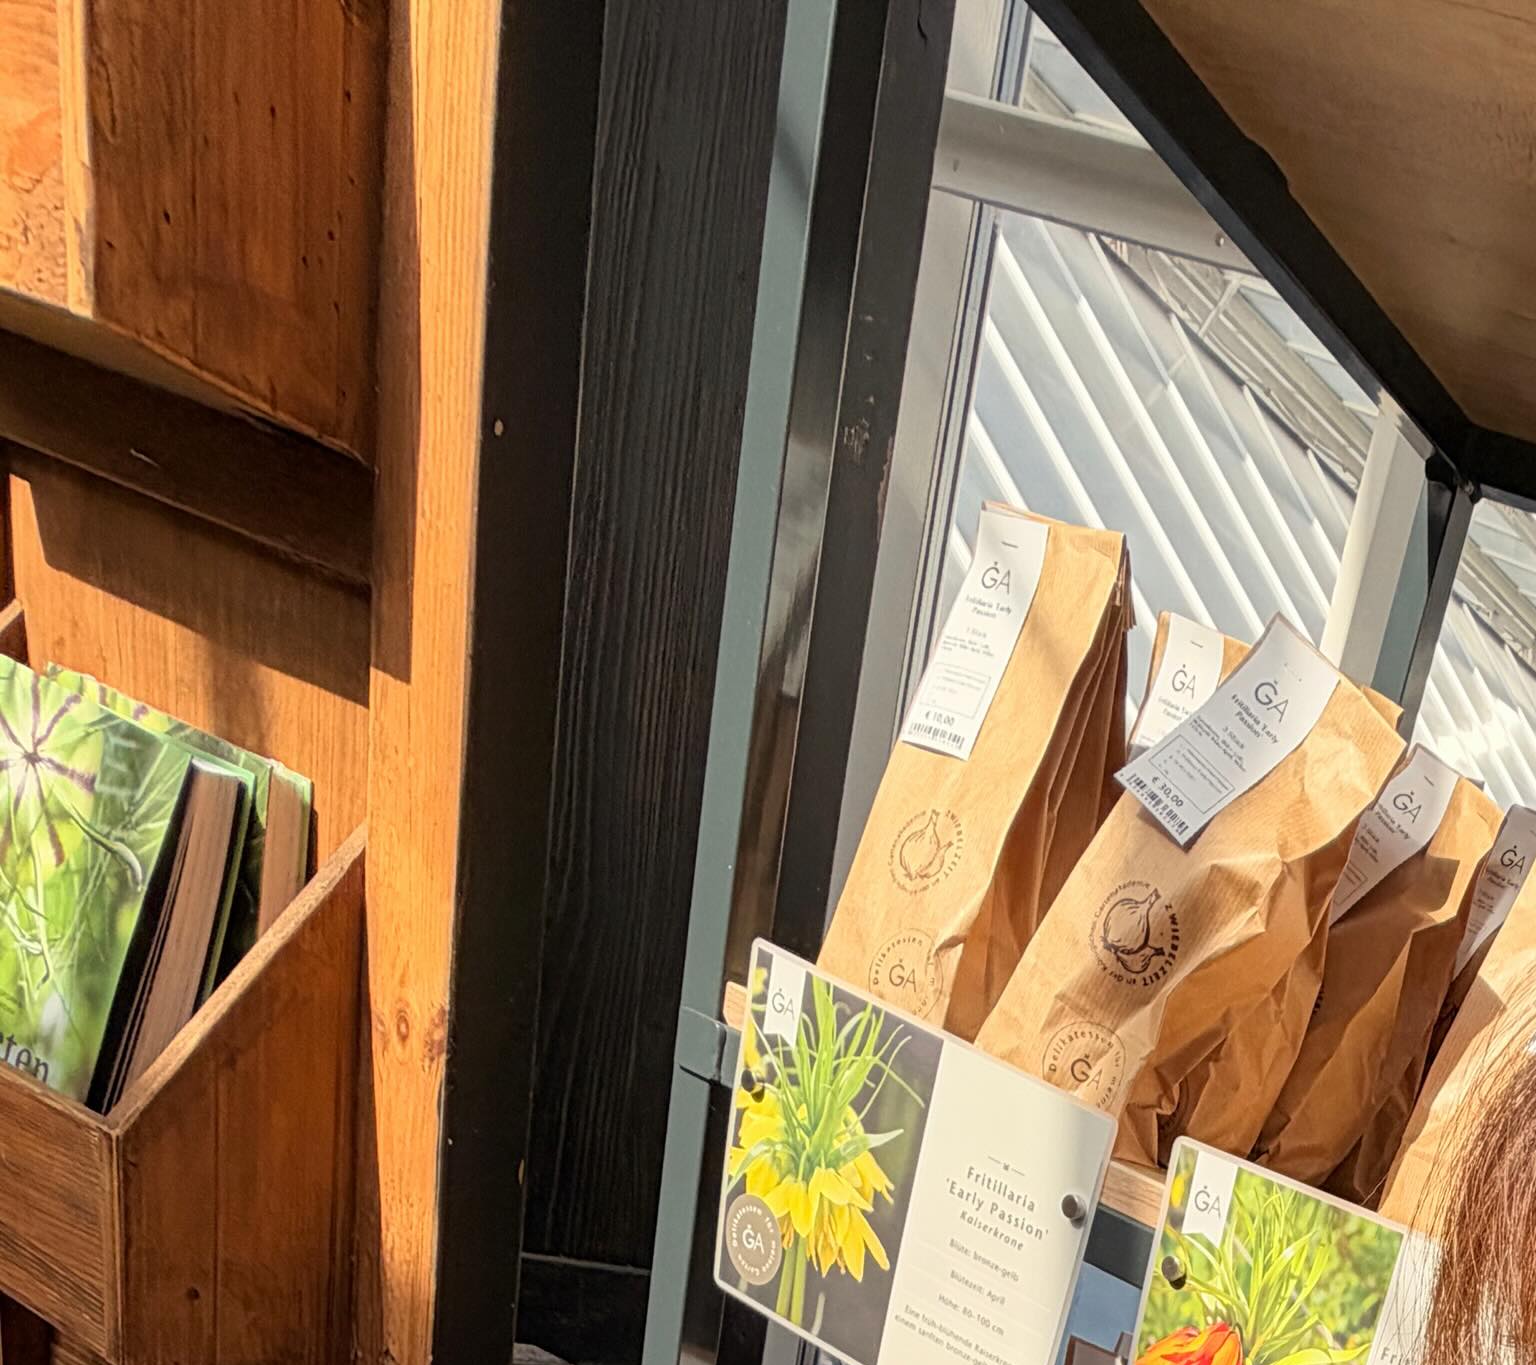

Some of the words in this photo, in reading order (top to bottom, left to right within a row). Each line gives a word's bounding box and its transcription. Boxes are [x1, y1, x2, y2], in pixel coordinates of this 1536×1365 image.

[1158, 782, 1184, 808] 30,00
[967, 1166, 1036, 1212] Fritillaria
[946, 1177, 986, 1211] 'Early
[989, 1203, 1049, 1241] Passion'
[959, 1210, 1025, 1252] Kaiserkrone
[938, 1293, 960, 1312] Höhe:
[949, 1270, 985, 1296] Blütezeit:
[986, 1291, 1006, 1306] April
